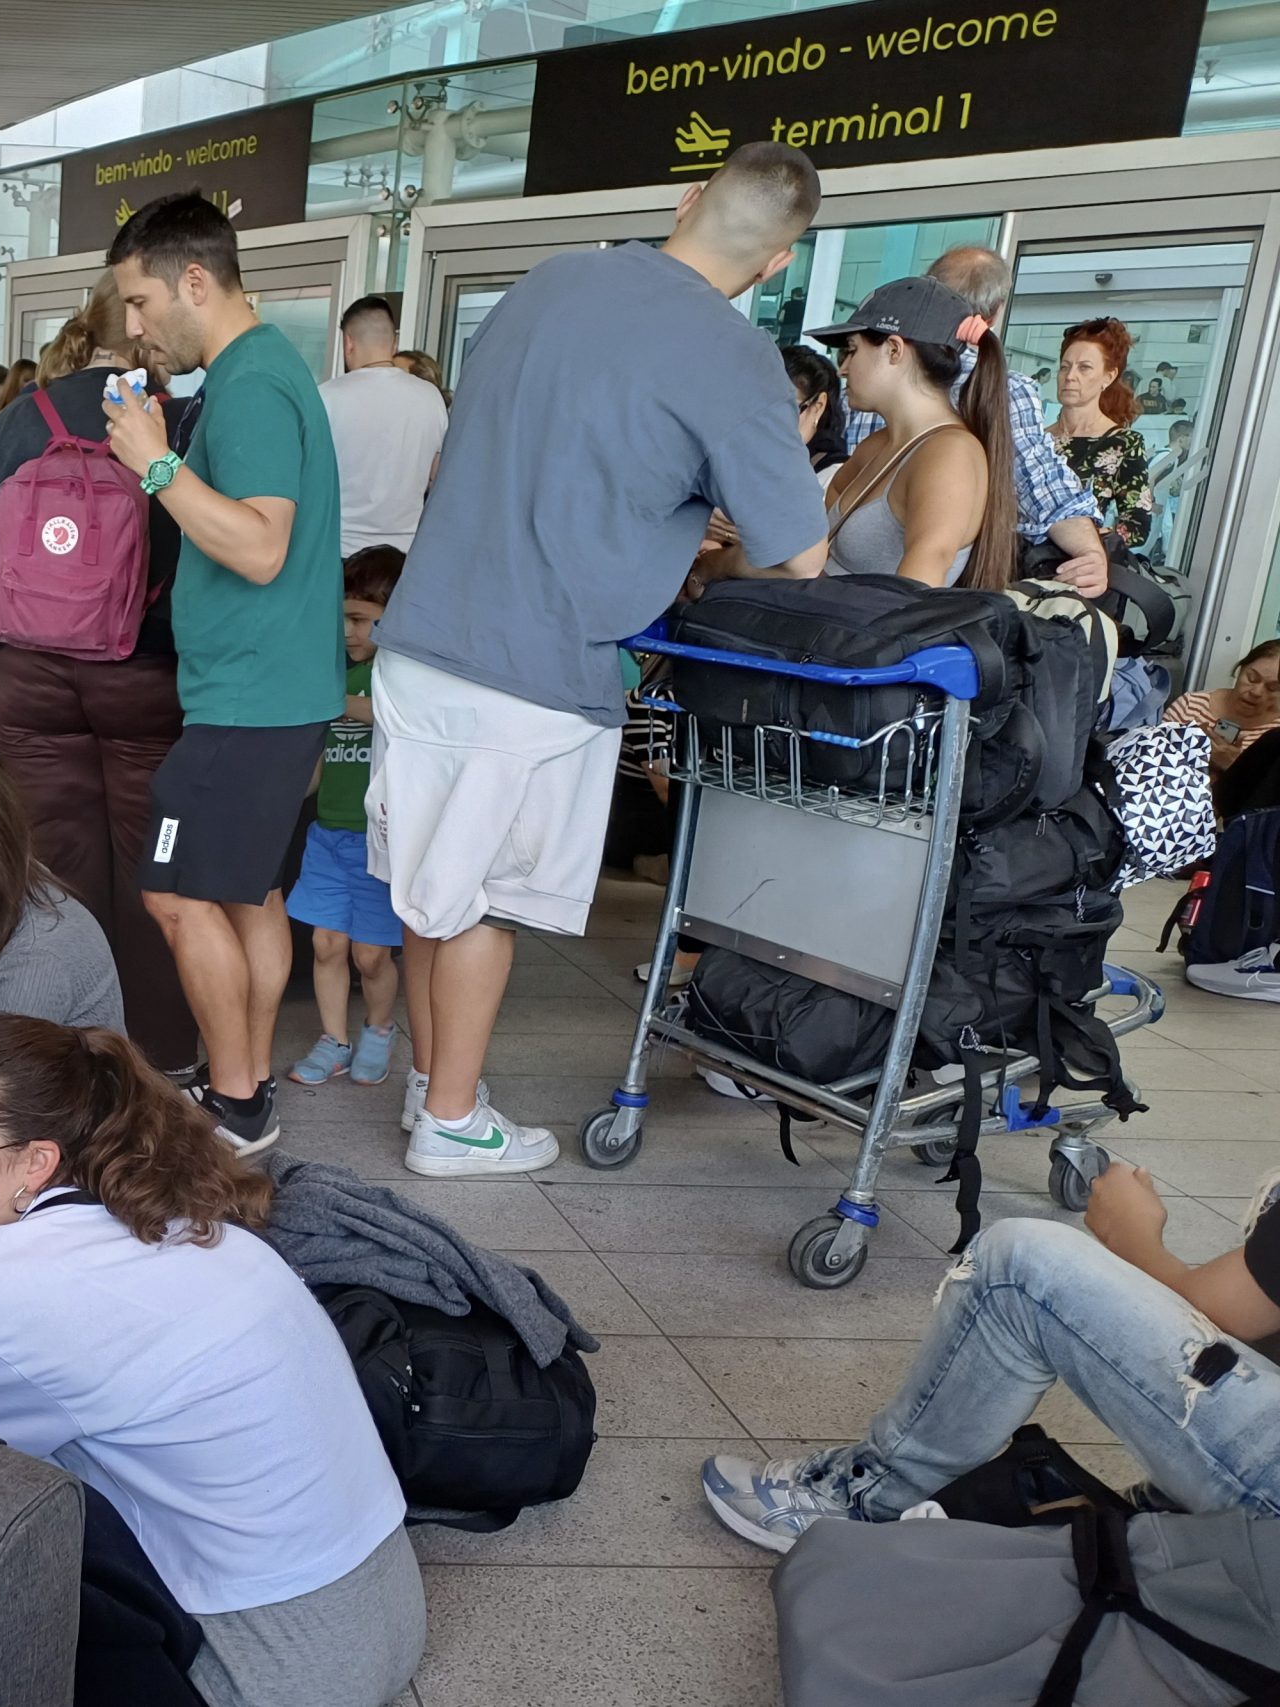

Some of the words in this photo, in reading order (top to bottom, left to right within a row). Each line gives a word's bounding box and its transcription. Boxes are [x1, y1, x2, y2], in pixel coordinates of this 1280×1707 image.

[626, 36, 826, 96] bem-vindo
[866, 7, 1058, 61] welcome
[770, 95, 944, 148] terminal
[959, 92, 972, 130] 1
[95, 149, 173, 186] bem-vindo
[185, 134, 258, 167] welcome
[876, 322, 900, 332] LONDON
[325, 743, 372, 762] adida
[161, 823, 173, 854] adidas
